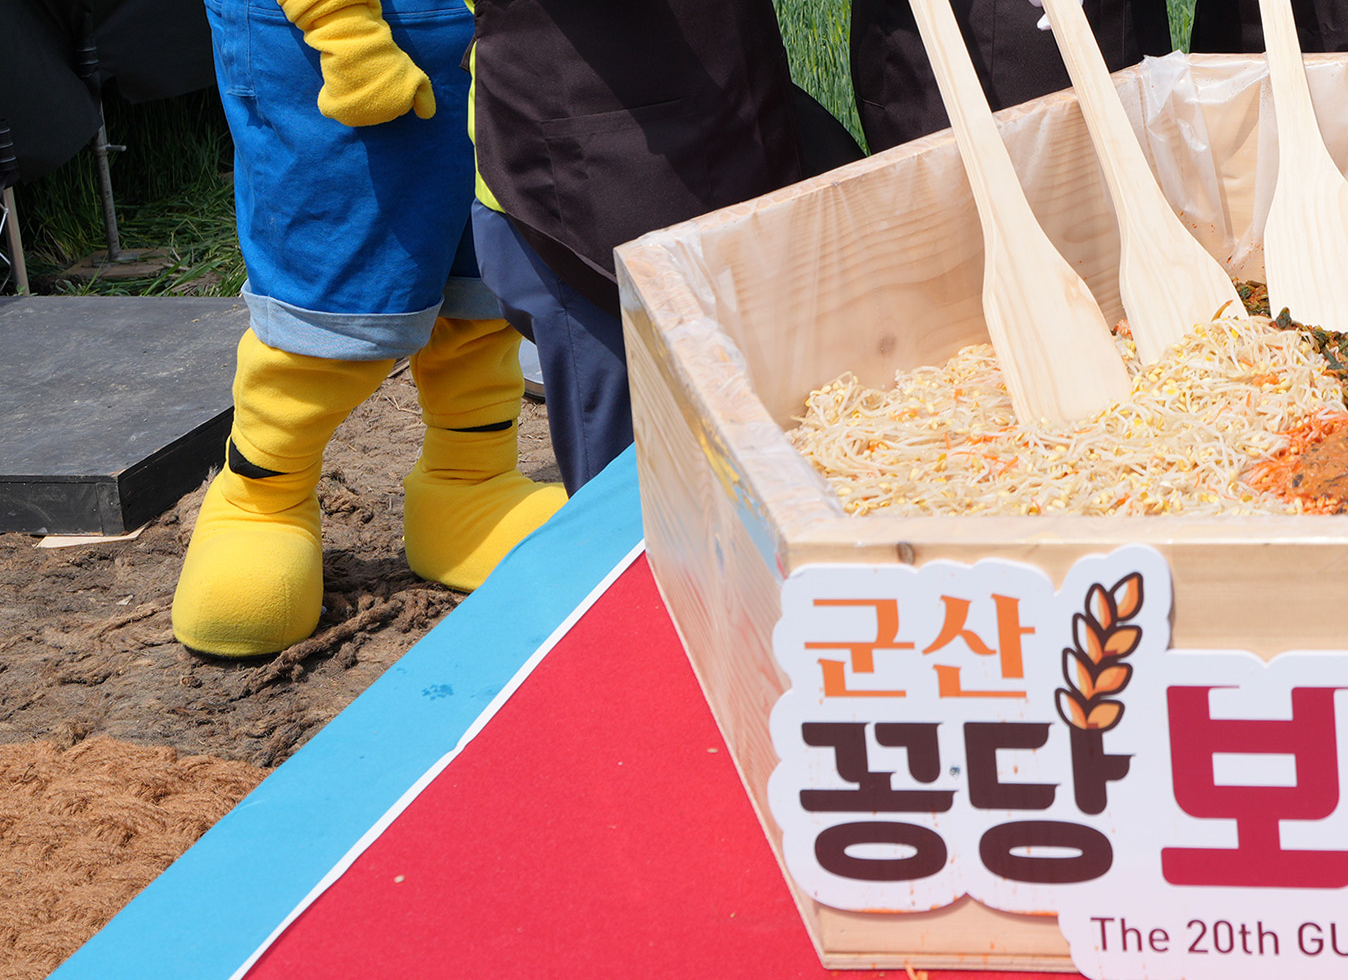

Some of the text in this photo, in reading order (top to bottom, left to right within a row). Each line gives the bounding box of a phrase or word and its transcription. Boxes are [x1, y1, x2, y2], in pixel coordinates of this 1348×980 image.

[803, 593, 1036, 699] 군산
[798, 721, 1137, 886] 꽁당
[1090, 916, 1170, 953] The
[1185, 919, 1280, 956] 20th
